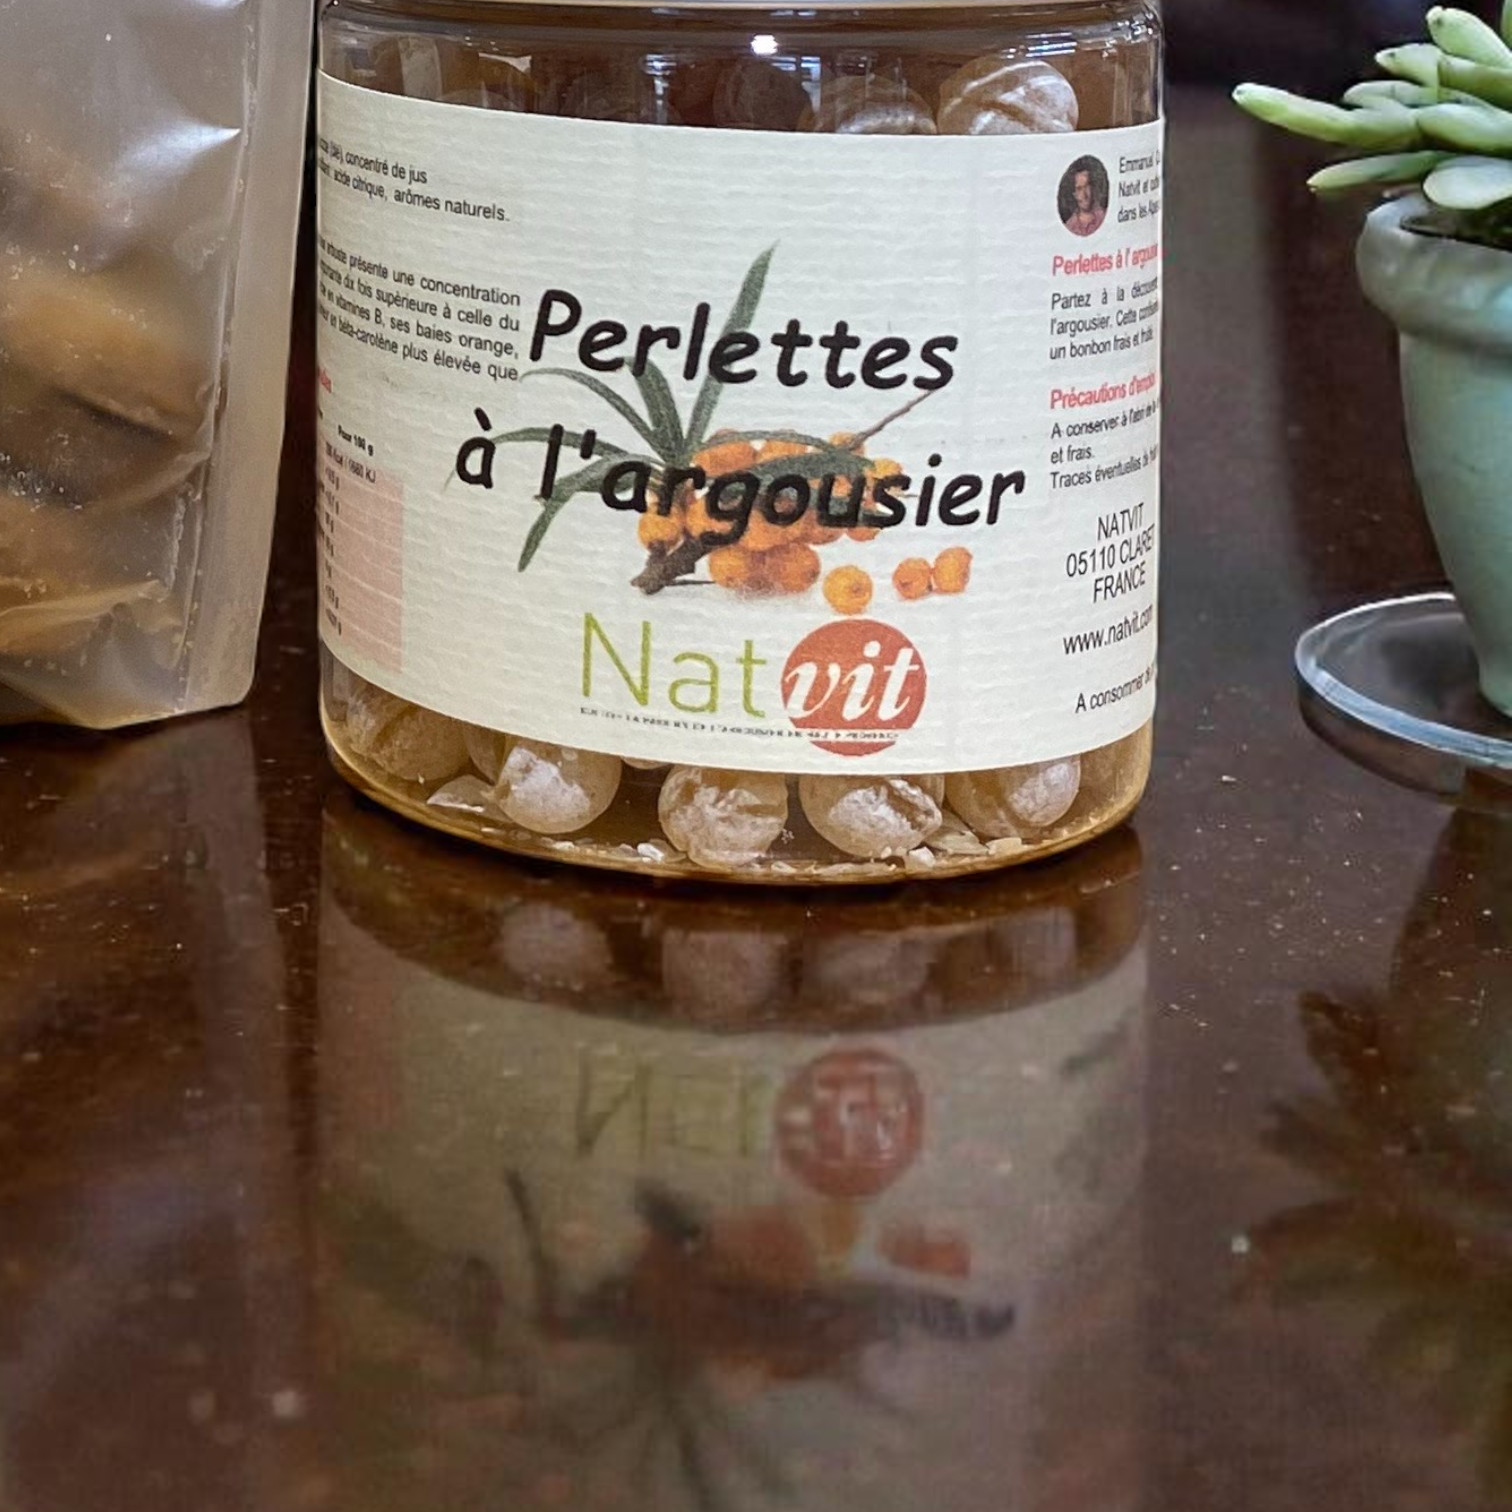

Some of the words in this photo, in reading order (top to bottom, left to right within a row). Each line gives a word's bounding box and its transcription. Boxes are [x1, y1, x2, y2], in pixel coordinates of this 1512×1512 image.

[346, 152, 388, 175] concentré
[392, 164, 406, 179] de
[408, 166, 427, 185] jus
[394, 188, 440, 210] arômes
[445, 199, 510, 222] naturels.
[1053, 252, 1112, 276] Perlettes
[1116, 248, 1122, 268] à
[349, 254, 387, 278] présente
[393, 269, 415, 286] une
[420, 276, 520, 307] concentration
[1051, 292, 1091, 310] Partez
[1102, 289, 1108, 305] à
[443, 302, 451, 319] à
[457, 310, 492, 326] celle
[499, 313, 520, 331] du
[1051, 311, 1113, 338] l'argousier.
[375, 307, 385, 327] B,
[390, 318, 410, 333] ses
[416, 320, 452, 344] baies
[459, 335, 519, 359] orange,
[530, 288, 958, 389] Perlettes
[1050, 342, 1066, 360] un
[1070, 336, 1111, 358] bonbon
[402, 343, 428, 362] plus
[434, 348, 481, 374] élevée
[488, 362, 518, 382] que
[1051, 382, 1126, 409] Précautions
[1051, 423, 1061, 439] A
[1066, 416, 1119, 437] conserver
[1051, 447, 1063, 464] et
[1067, 445, 1094, 462] frais.
[456, 407, 496, 488] à
[538, 424, 1025, 548] l'argousier
[1050, 470, 1091, 489] Traces
[1097, 503, 1144, 541] NATVIT
[1066, 544, 1115, 578] 05110
[1093, 560, 1146, 603] FRANCE
[1075, 692, 1087, 713] A
